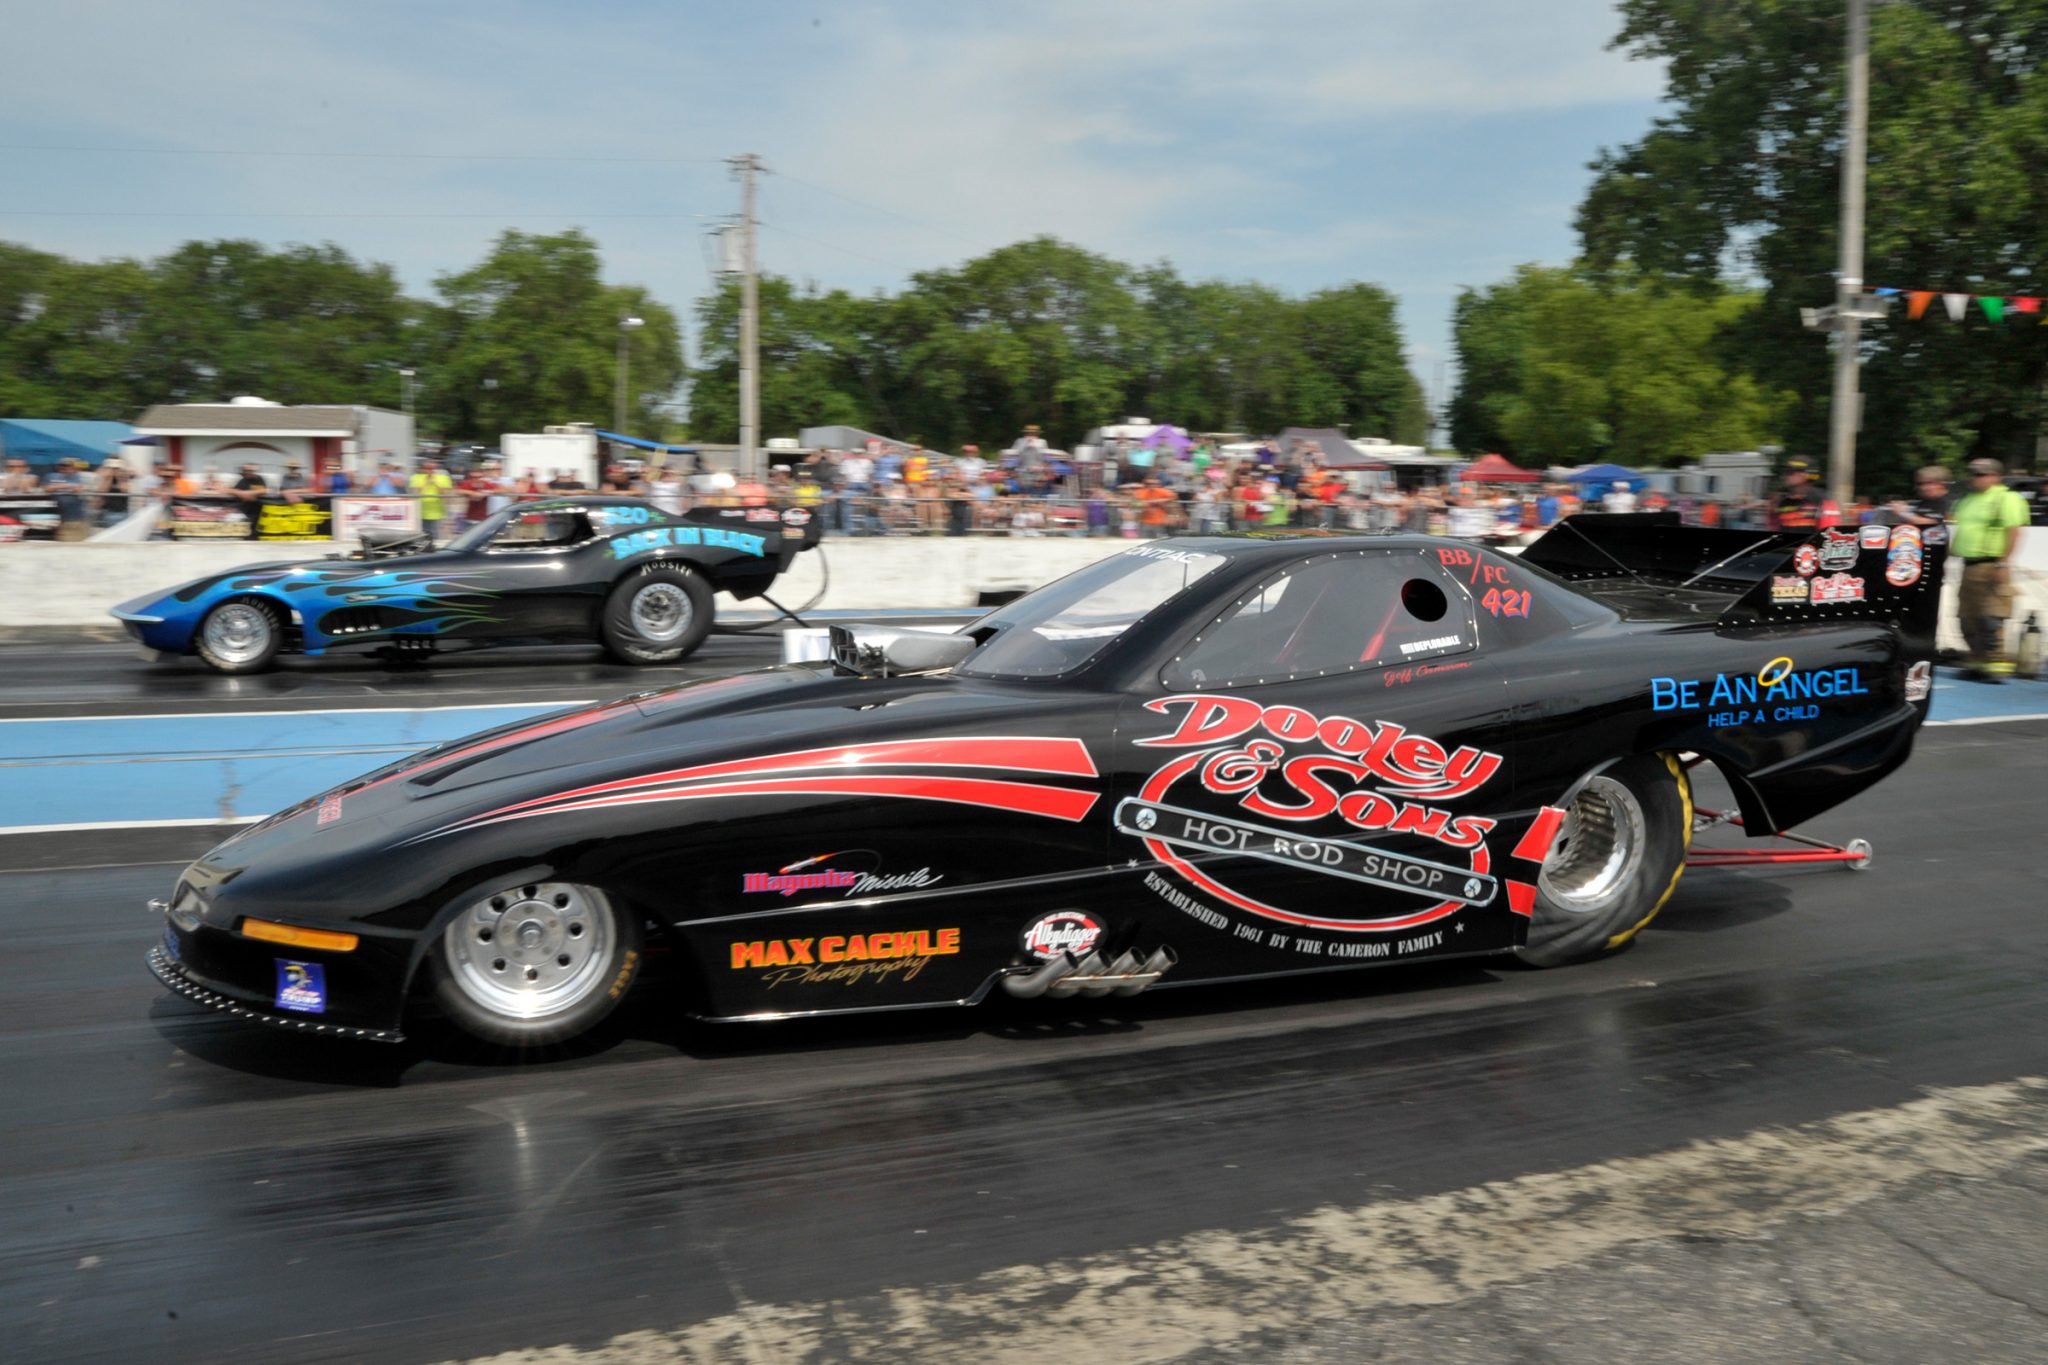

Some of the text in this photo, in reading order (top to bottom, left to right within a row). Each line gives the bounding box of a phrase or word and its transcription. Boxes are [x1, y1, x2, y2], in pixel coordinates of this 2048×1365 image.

[602, 506, 649, 525] 520
[609, 527, 766, 560] BACK IN BLACK
[1125, 547, 1206, 564] ONTIAC
[1481, 587, 1532, 618] 421
[1708, 704, 1820, 728] HELP A CHILD
[1182, 818, 1445, 889] HOT ROD SHOP
[1143, 870, 1229, 931] ESTABLISHED
[1233, 922, 1264, 944] 1961
[1268, 933, 1290, 950] BY
[1295, 938, 1323, 955] THE
[1327, 942, 1391, 958] CAMERON
[730, 927, 961, 969] MAX CACKLE
[761, 955, 932, 990] Photography
